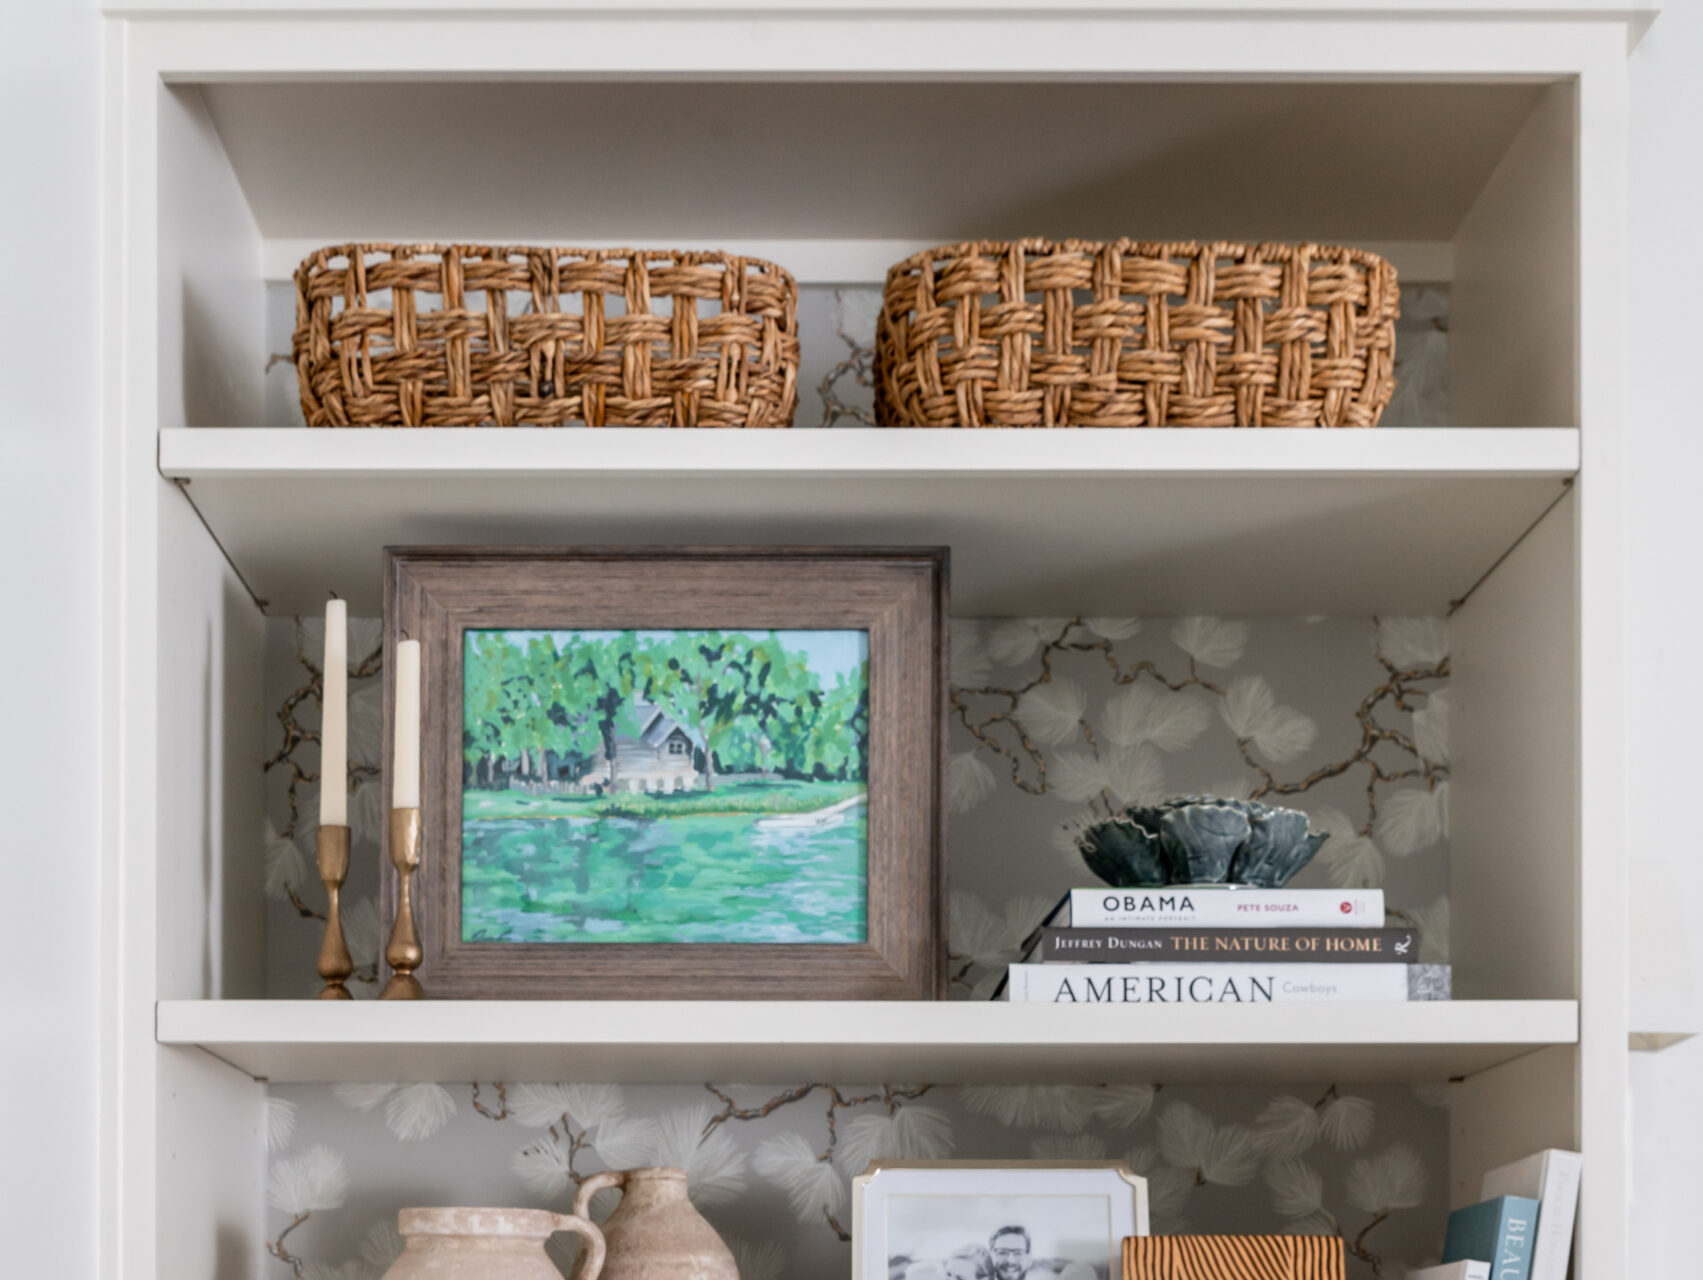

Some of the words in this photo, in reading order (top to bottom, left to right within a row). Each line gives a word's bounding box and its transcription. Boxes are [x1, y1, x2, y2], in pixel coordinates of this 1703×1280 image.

[1103, 896, 1195, 912] OBAMA
[1237, 904, 1261, 912] PETE
[1264, 904, 1299, 912] SOUZA
[1170, 936, 1209, 951] THE
[1215, 936, 1290, 951] NATURE
[1294, 936, 1320, 951] OF
[1325, 936, 1382, 952] HOME
[1053, 976, 1276, 1003] AMERICAN
[1282, 981, 1338, 995] Cowboys
